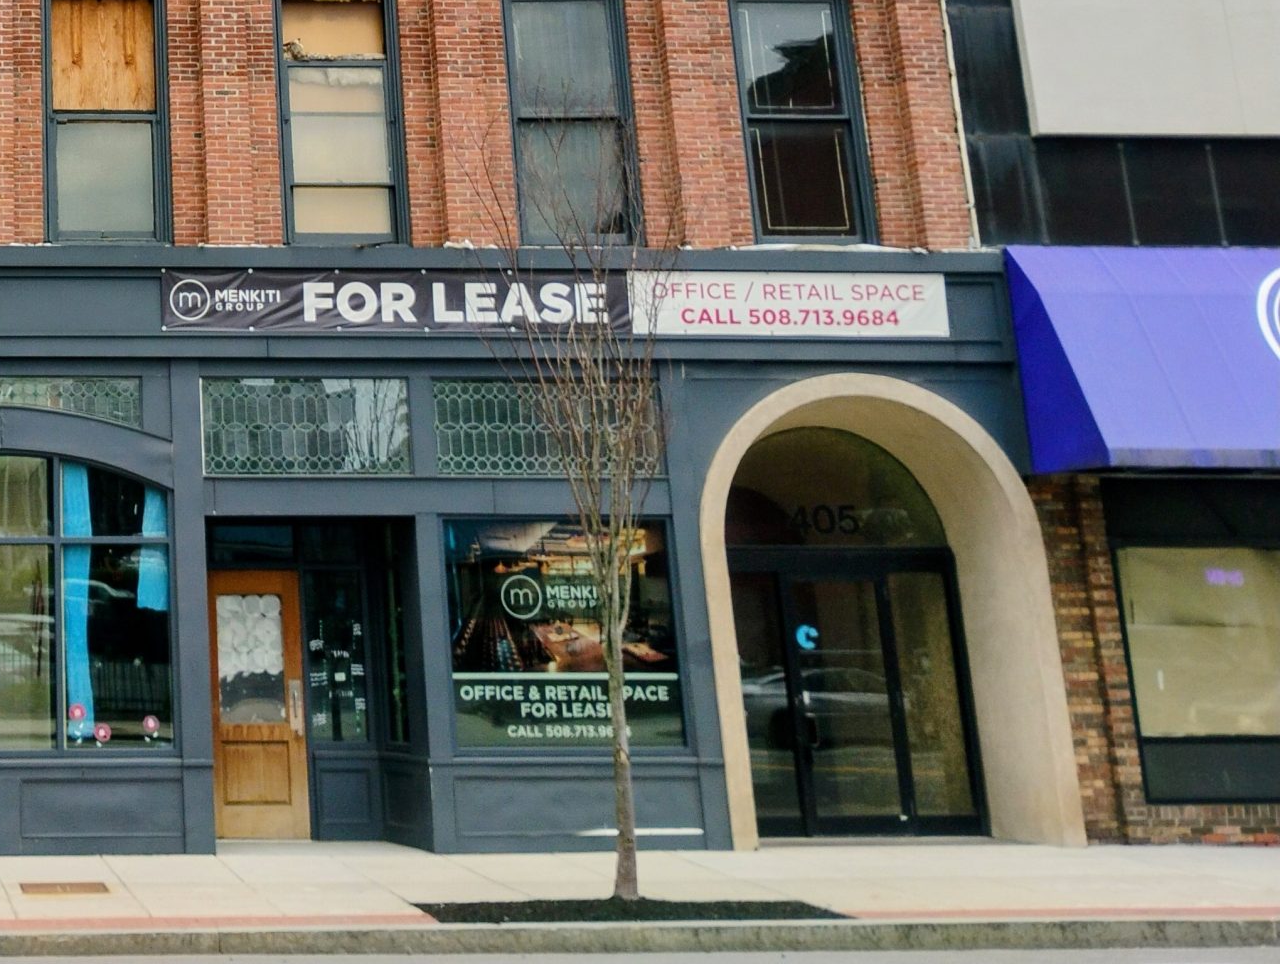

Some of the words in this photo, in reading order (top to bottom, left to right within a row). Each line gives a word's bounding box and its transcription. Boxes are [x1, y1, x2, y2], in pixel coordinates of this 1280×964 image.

[215, 289, 280, 303] MENKITI
[652, 282, 736, 300] OFFICE
[763, 284, 843, 301] RETAIL
[851, 284, 925, 301] SPACE
[215, 302, 264, 311] GROUP
[303, 282, 417, 323] FOR
[432, 282, 609, 323] LEASE
[681, 308, 741, 325] CALL
[749, 309, 900, 326] 508.713.9684
[791, 504, 860, 535] 405
[545, 585, 597, 599] MENKI
[460, 685, 524, 701] OFFICE
[528, 686, 541, 701] &
[545, 685, 608, 701] RETAIL
[622, 685, 669, 701] PACE
[521, 702, 558, 718] FOR
[508, 725, 543, 738] CALL
